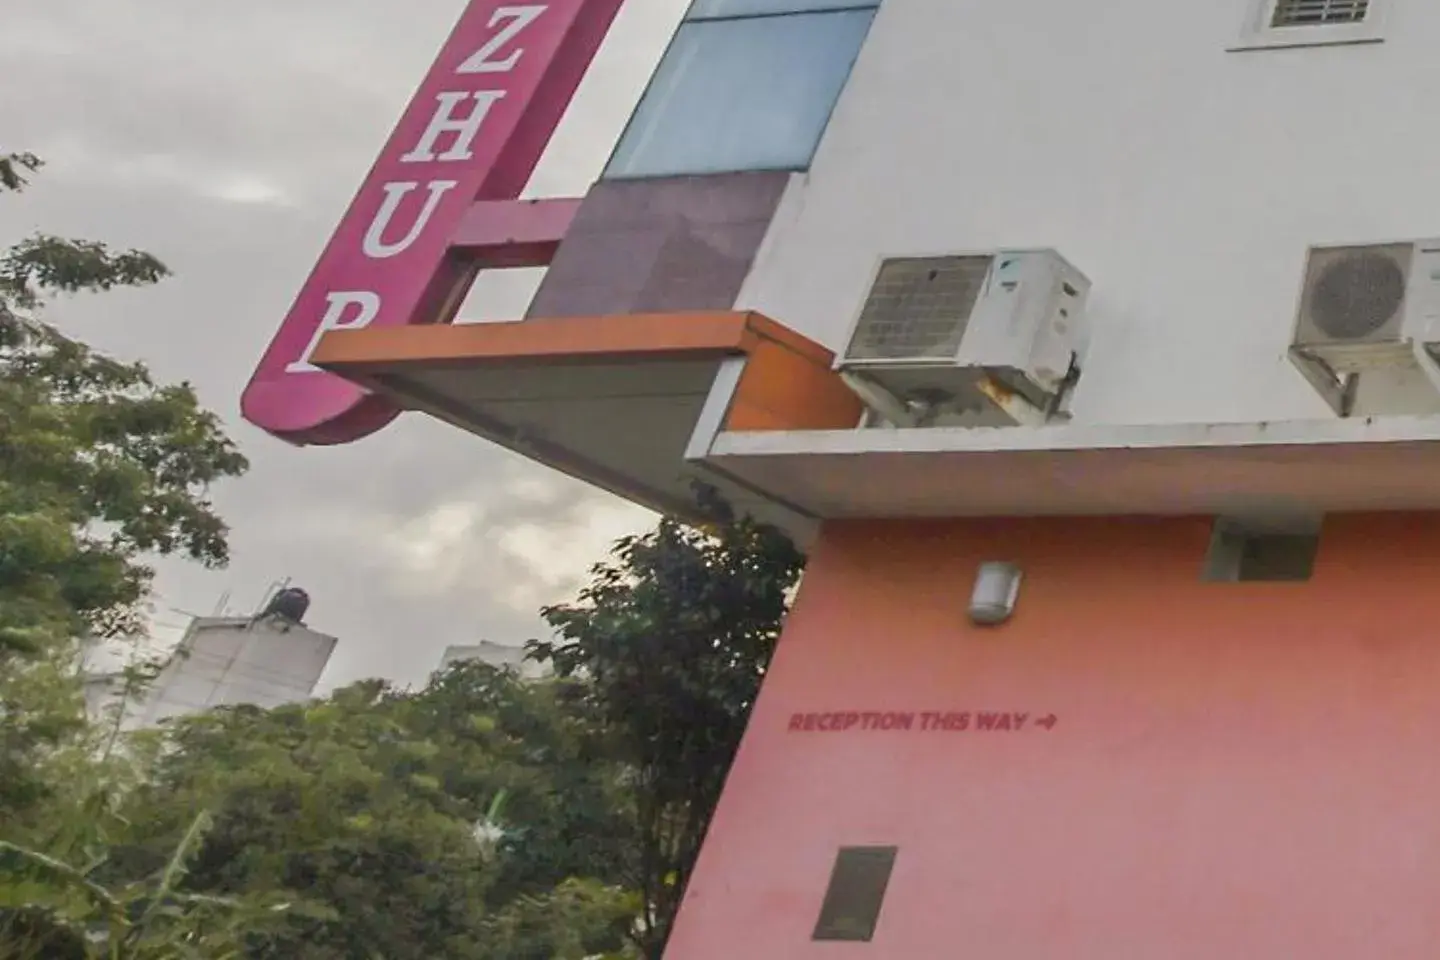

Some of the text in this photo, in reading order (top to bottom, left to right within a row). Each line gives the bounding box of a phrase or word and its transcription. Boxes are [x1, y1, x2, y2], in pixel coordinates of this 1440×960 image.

[787, 711, 1029, 732] RECEPTION THIS WAY
